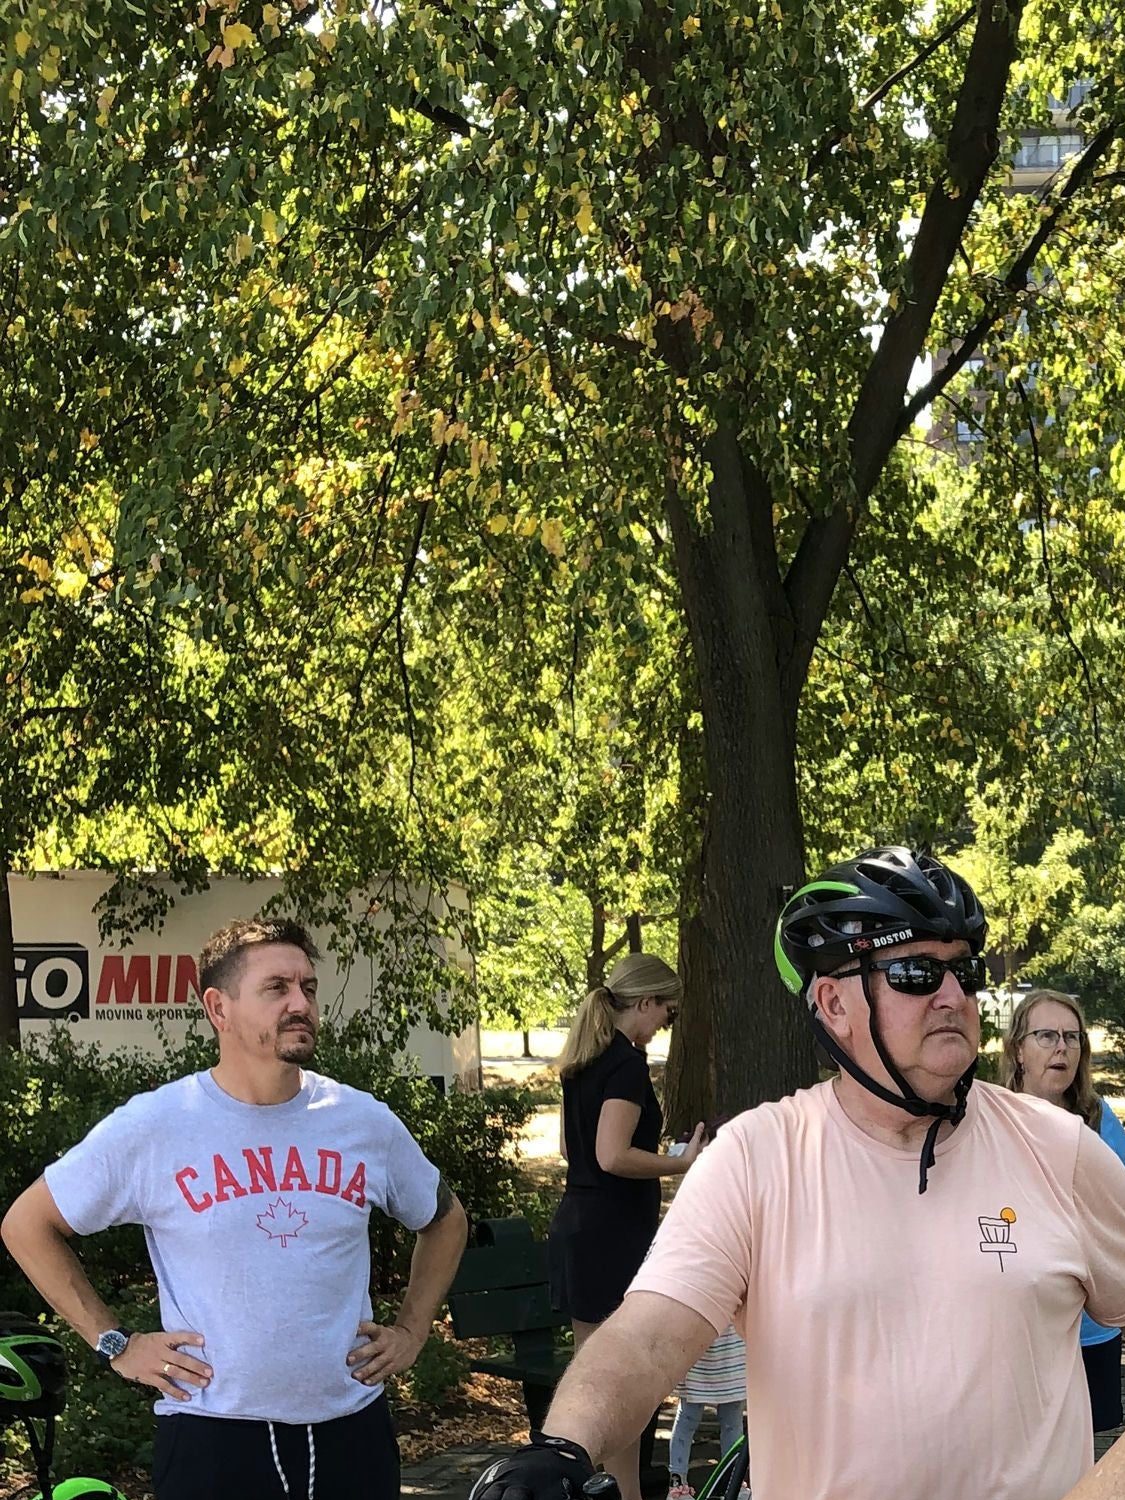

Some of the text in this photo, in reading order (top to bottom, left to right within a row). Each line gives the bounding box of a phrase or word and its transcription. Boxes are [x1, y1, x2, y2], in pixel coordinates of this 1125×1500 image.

[872, 928, 914, 948] BOSTON
[95, 1009, 143, 1021] MOVING
[175, 1146, 367, 1214] CANADA
